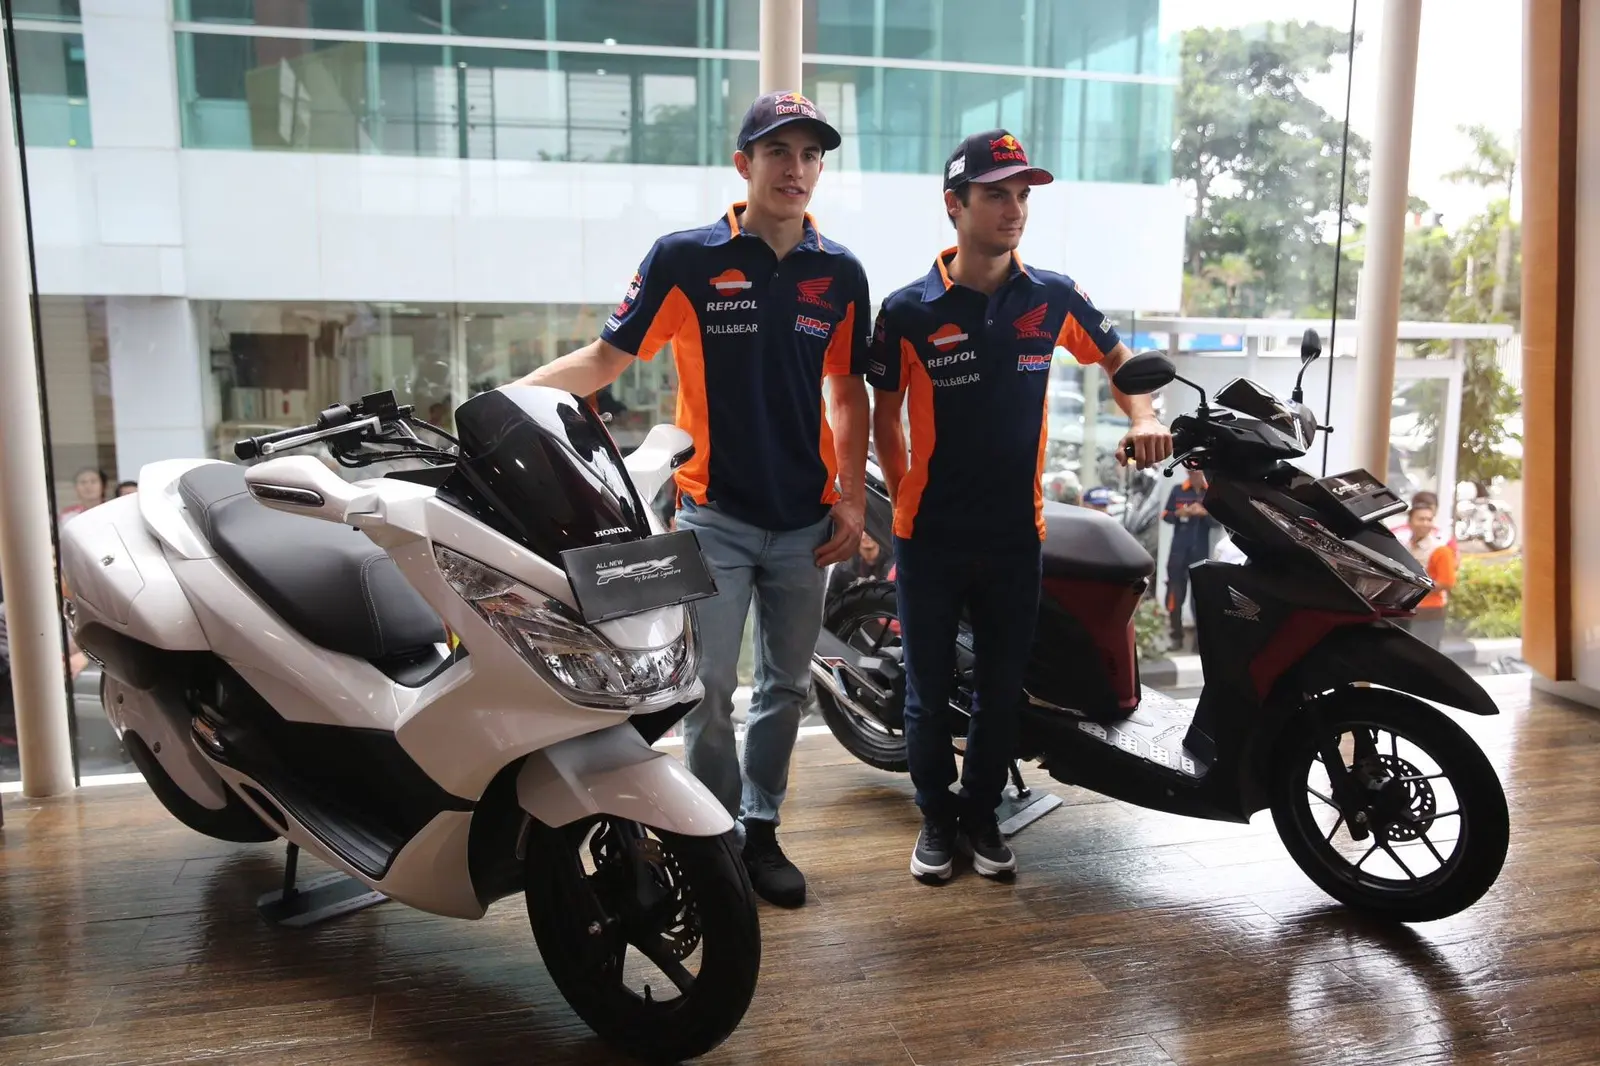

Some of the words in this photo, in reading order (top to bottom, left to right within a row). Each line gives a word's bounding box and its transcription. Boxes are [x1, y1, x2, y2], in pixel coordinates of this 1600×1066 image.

[775, 103, 800, 115] Red
[993, 150, 1015, 162] Red
[1014, 151, 1029, 163] Bu
[706, 300, 758, 311] REPSOL
[797, 295, 833, 310] HONDA
[706, 323, 758, 334] PULL&BEAR
[795, 314, 830, 338] HRC
[1016, 331, 1052, 339] HONDA
[927, 350, 976, 368] REPSOL
[1017, 353, 1051, 371] HRC
[932, 372, 980, 387] PULL&BEAR
[594, 526, 632, 537] HONDA
